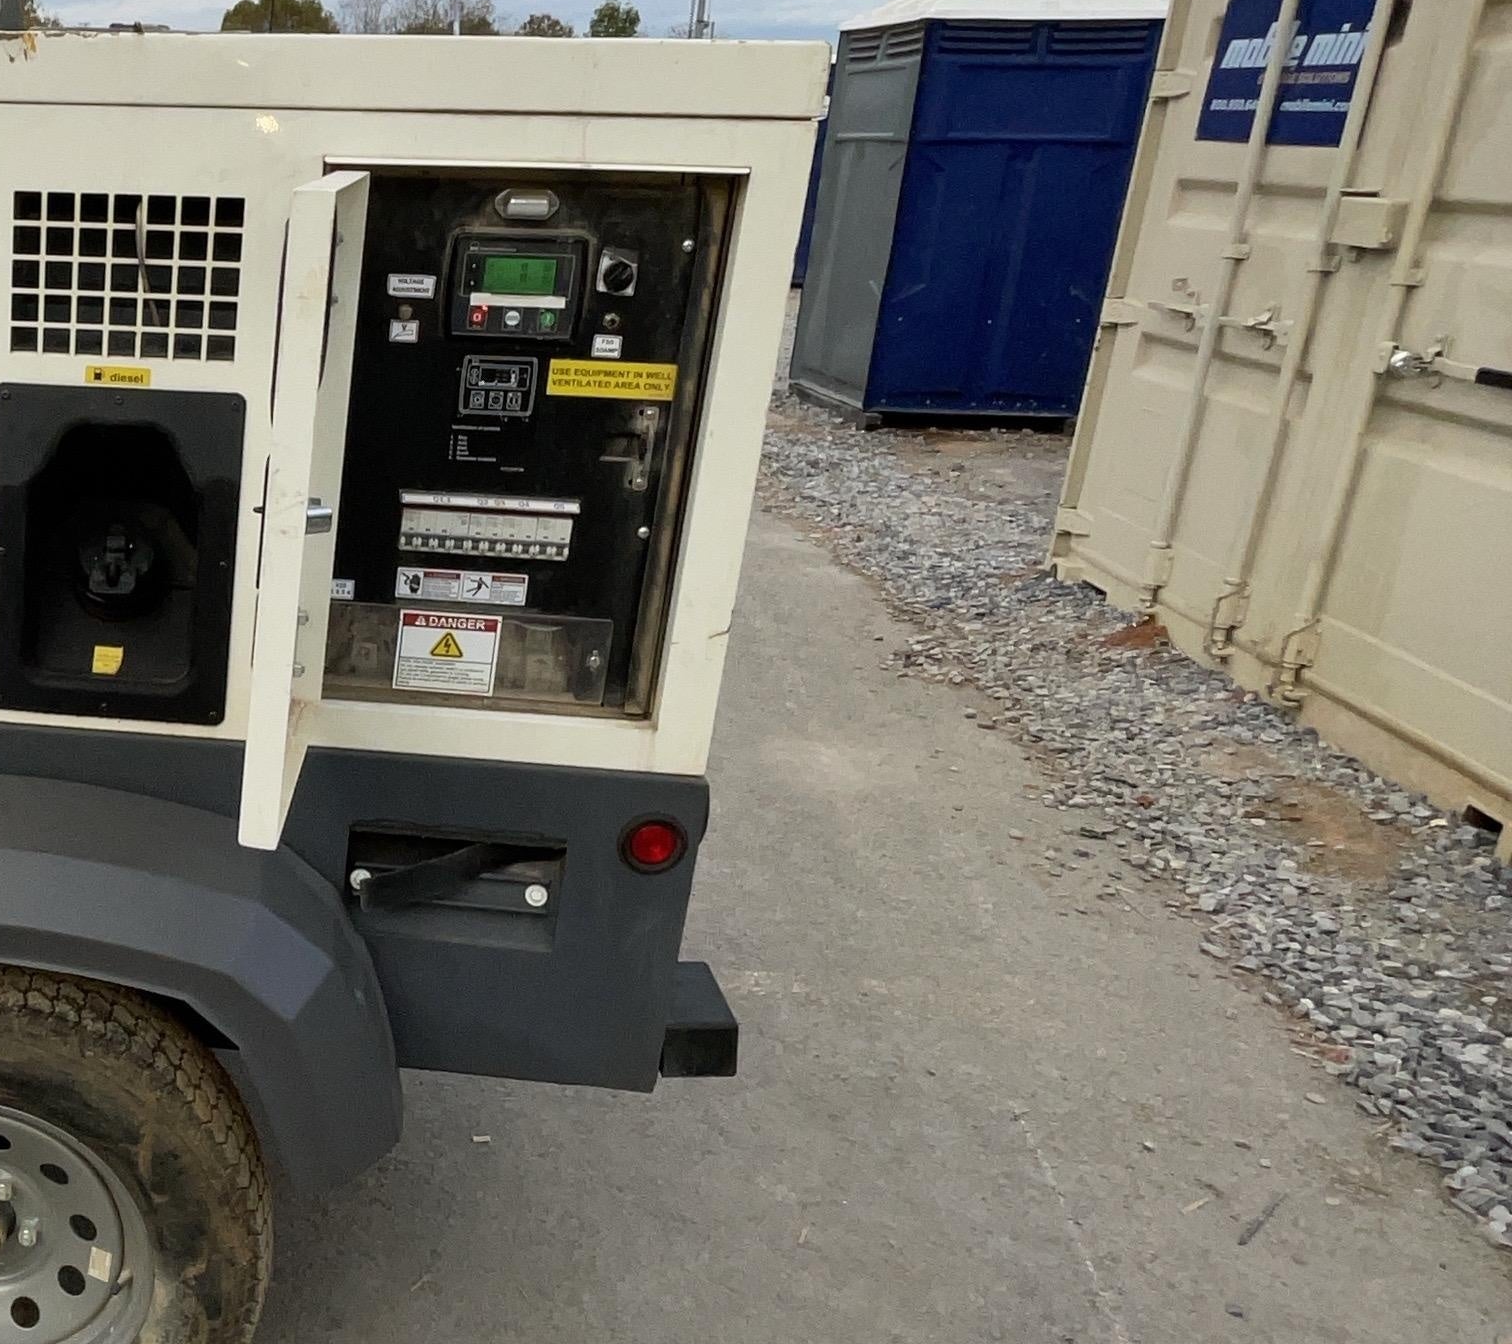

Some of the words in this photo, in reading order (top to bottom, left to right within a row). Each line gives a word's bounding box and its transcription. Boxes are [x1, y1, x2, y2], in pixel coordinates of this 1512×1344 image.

[109, 372, 144, 383] diesel
[551, 367, 570, 376] USE
[574, 368, 630, 379] EQUIPMENT
[633, 371, 643, 379] IN
[645, 371, 672, 380] WELL
[551, 378, 612, 389] VENTILATED
[613, 381, 641, 390] AREA
[643, 382, 670, 391] ONLY
[428, 617, 486, 631] DANGER
